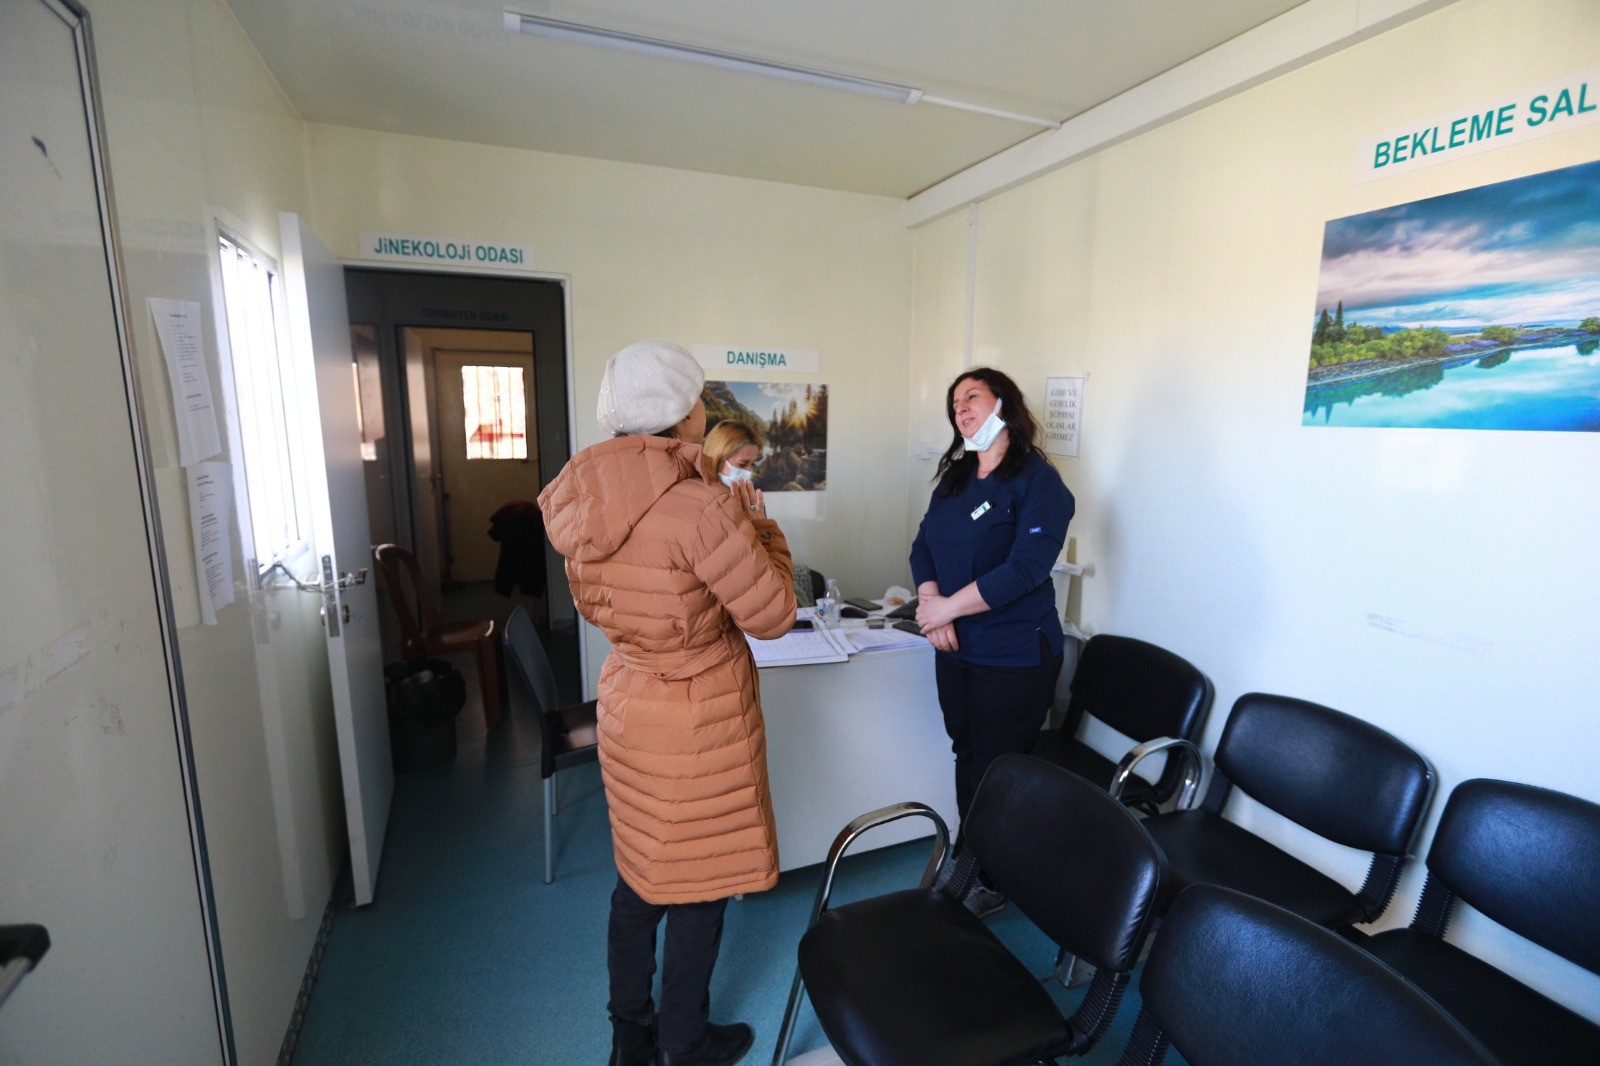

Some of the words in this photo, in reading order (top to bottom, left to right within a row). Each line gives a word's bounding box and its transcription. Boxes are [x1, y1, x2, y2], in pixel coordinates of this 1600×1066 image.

[1373, 103, 1517, 169] BEKLEME
[1526, 83, 1598, 127] SAL
[475, 246, 523, 264] ODASI
[726, 350, 787, 369] DANIŞMA
